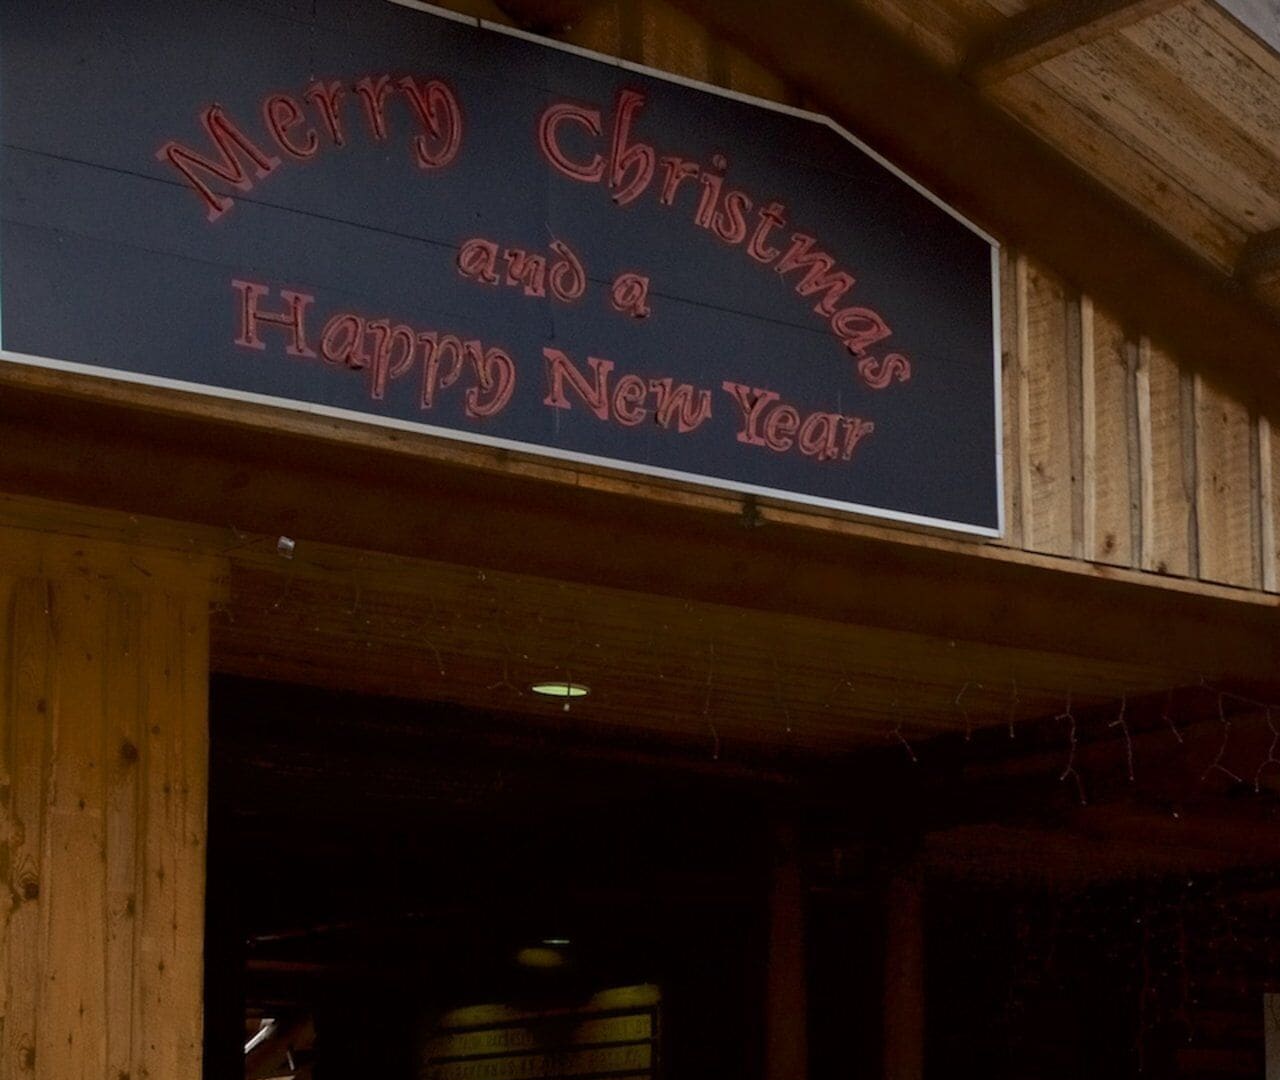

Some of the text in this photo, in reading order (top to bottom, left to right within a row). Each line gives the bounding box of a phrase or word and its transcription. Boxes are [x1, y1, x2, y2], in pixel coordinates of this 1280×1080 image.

[155, 75, 911, 389] Merry Christmas
[455, 235, 651, 319] and a
[231, 279, 874, 461] Happy New Year
